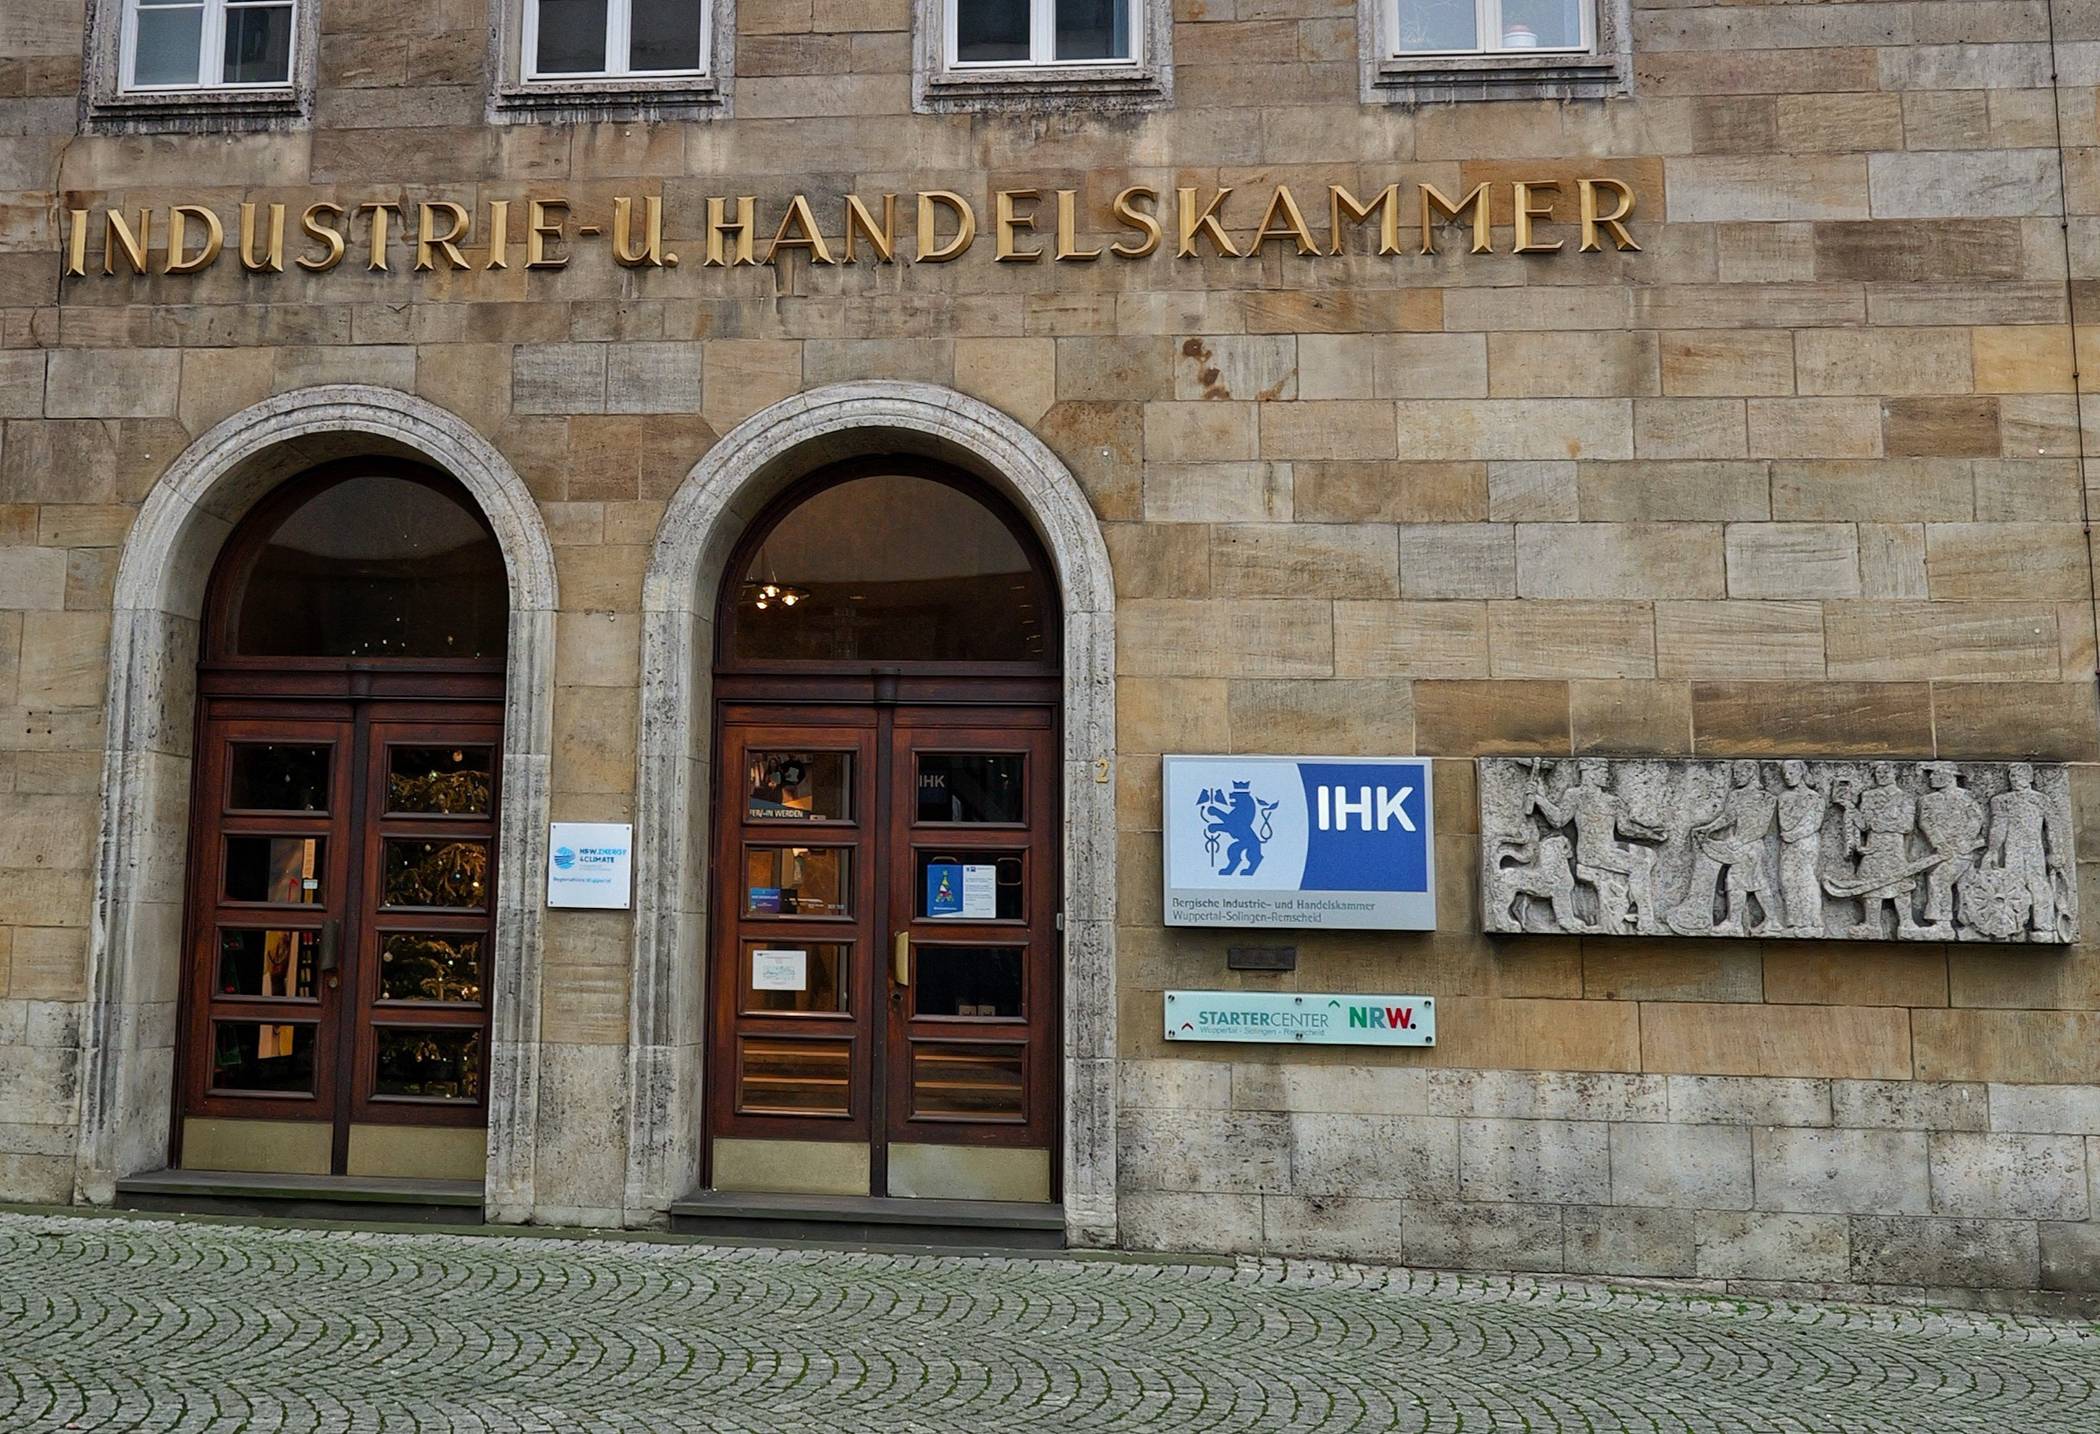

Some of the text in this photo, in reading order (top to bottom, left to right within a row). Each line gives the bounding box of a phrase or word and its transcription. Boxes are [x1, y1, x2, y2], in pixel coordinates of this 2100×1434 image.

[704, 177, 1643, 268] HANDELSKAMMER
[1095, 757, 1110, 784] 2
[919, 774, 945, 788] IHK
[775, 809, 804, 818] WERDEN
[1317, 786, 1416, 832] IHK
[1172, 897, 1376, 911] Bergische Industrie- und Handelskammer
[1172, 910, 1322, 924] Wuppertal-Solingen-Remscheid
[1199, 1011, 1329, 1028] STARTERCENTER
[1199, 1026, 1239, 1036] Wuppertal
[1244, 1027, 1277, 1037] Solingen
